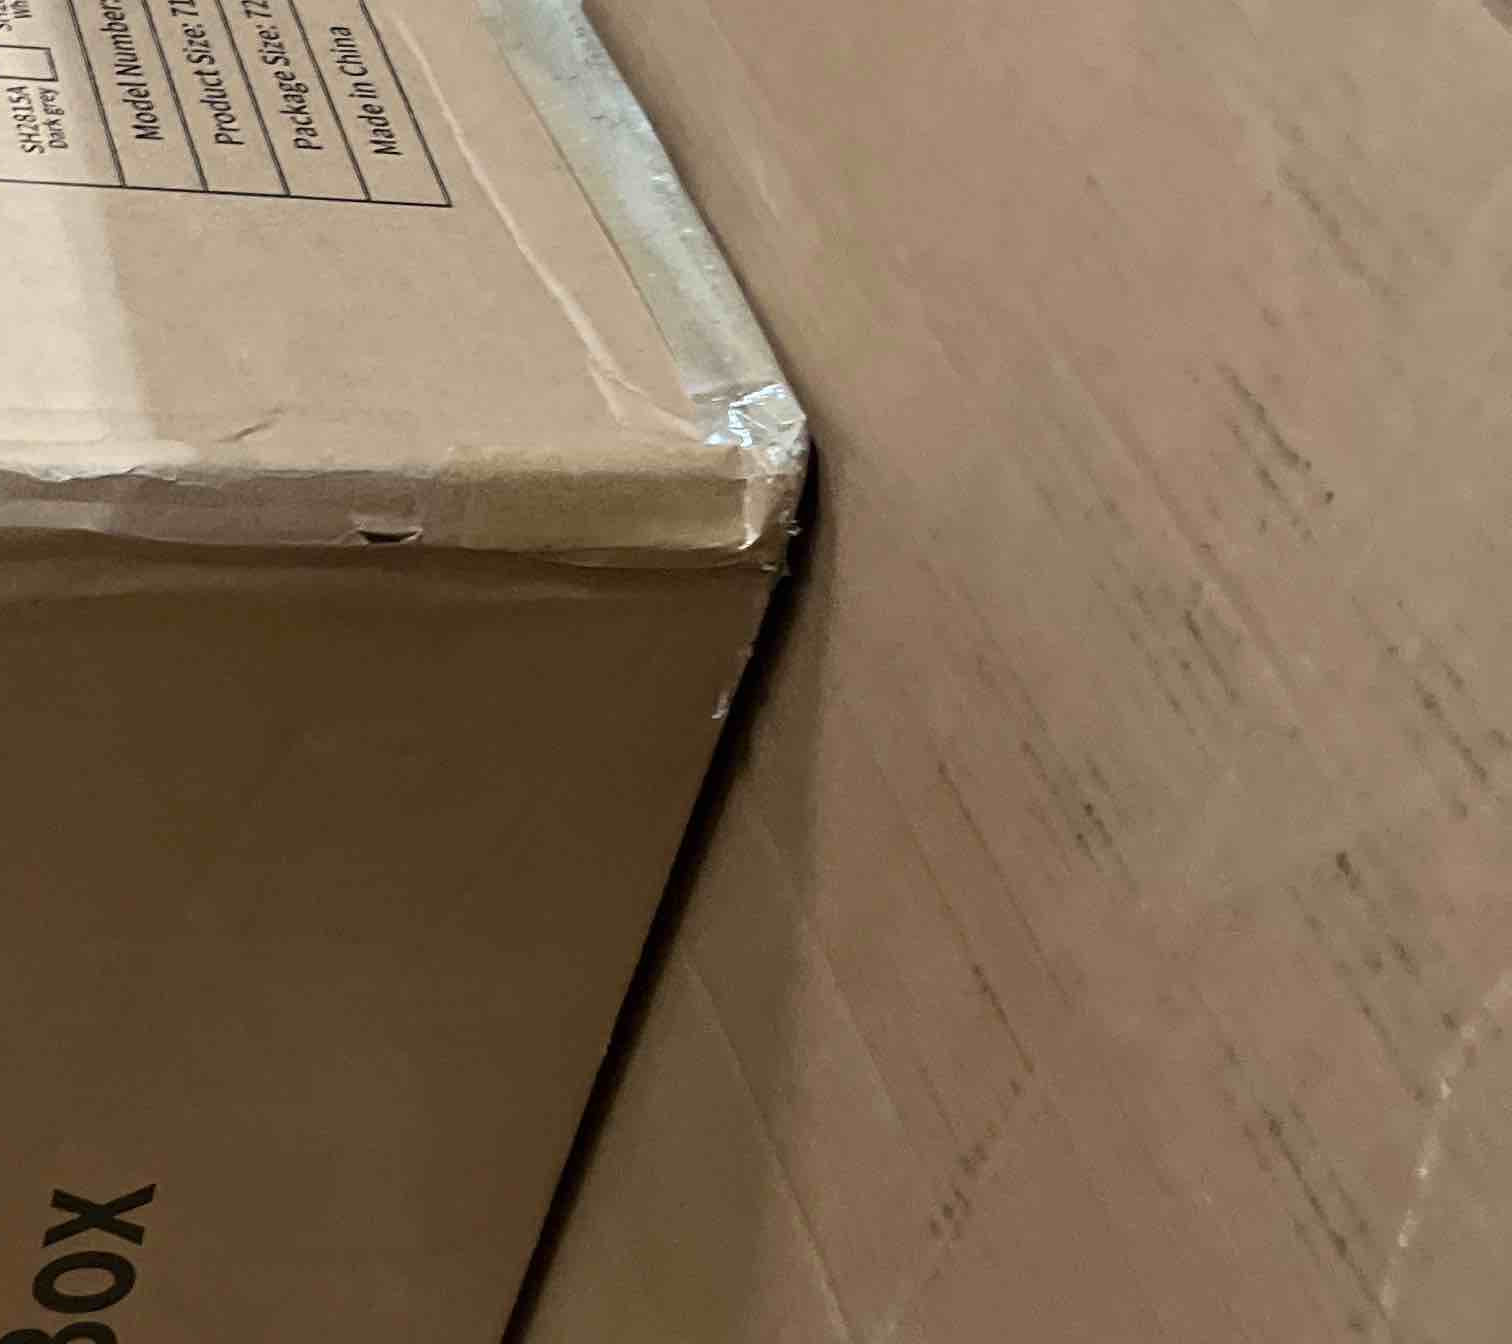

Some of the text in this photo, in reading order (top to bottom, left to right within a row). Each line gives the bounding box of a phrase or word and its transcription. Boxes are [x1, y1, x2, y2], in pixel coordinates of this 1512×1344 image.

[181, 22, 216, 67] Size:
[255, 23, 292, 68] Size:
[6, 85, 45, 155] SH2815A
[39, 87, 69, 150] Dark grey
[117, 82, 165, 142] Model
[193, 68, 246, 146] Product
[273, 69, 324, 152] Package
[328, 24, 404, 157] Made in China
